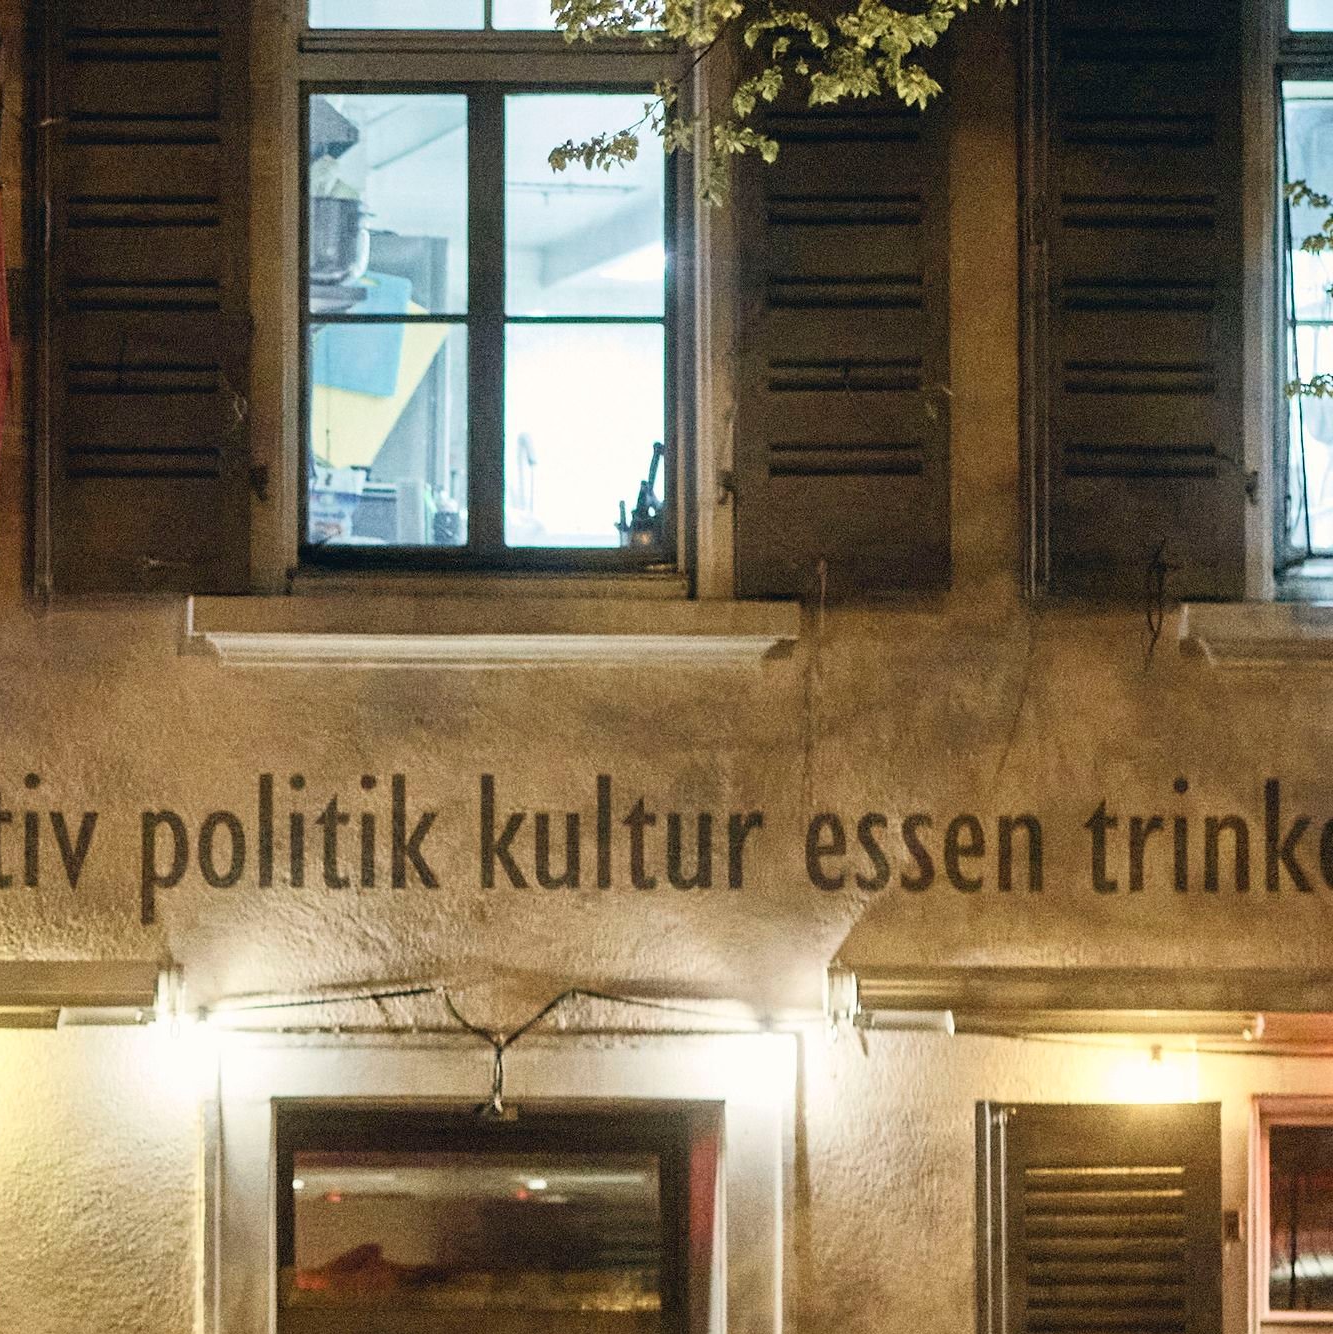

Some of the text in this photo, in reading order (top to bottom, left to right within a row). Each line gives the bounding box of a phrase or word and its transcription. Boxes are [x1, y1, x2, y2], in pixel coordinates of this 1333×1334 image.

[139, 772, 441, 927] politik
[479, 772, 765, 891] kultur
[804, 811, 1045, 893] essen
